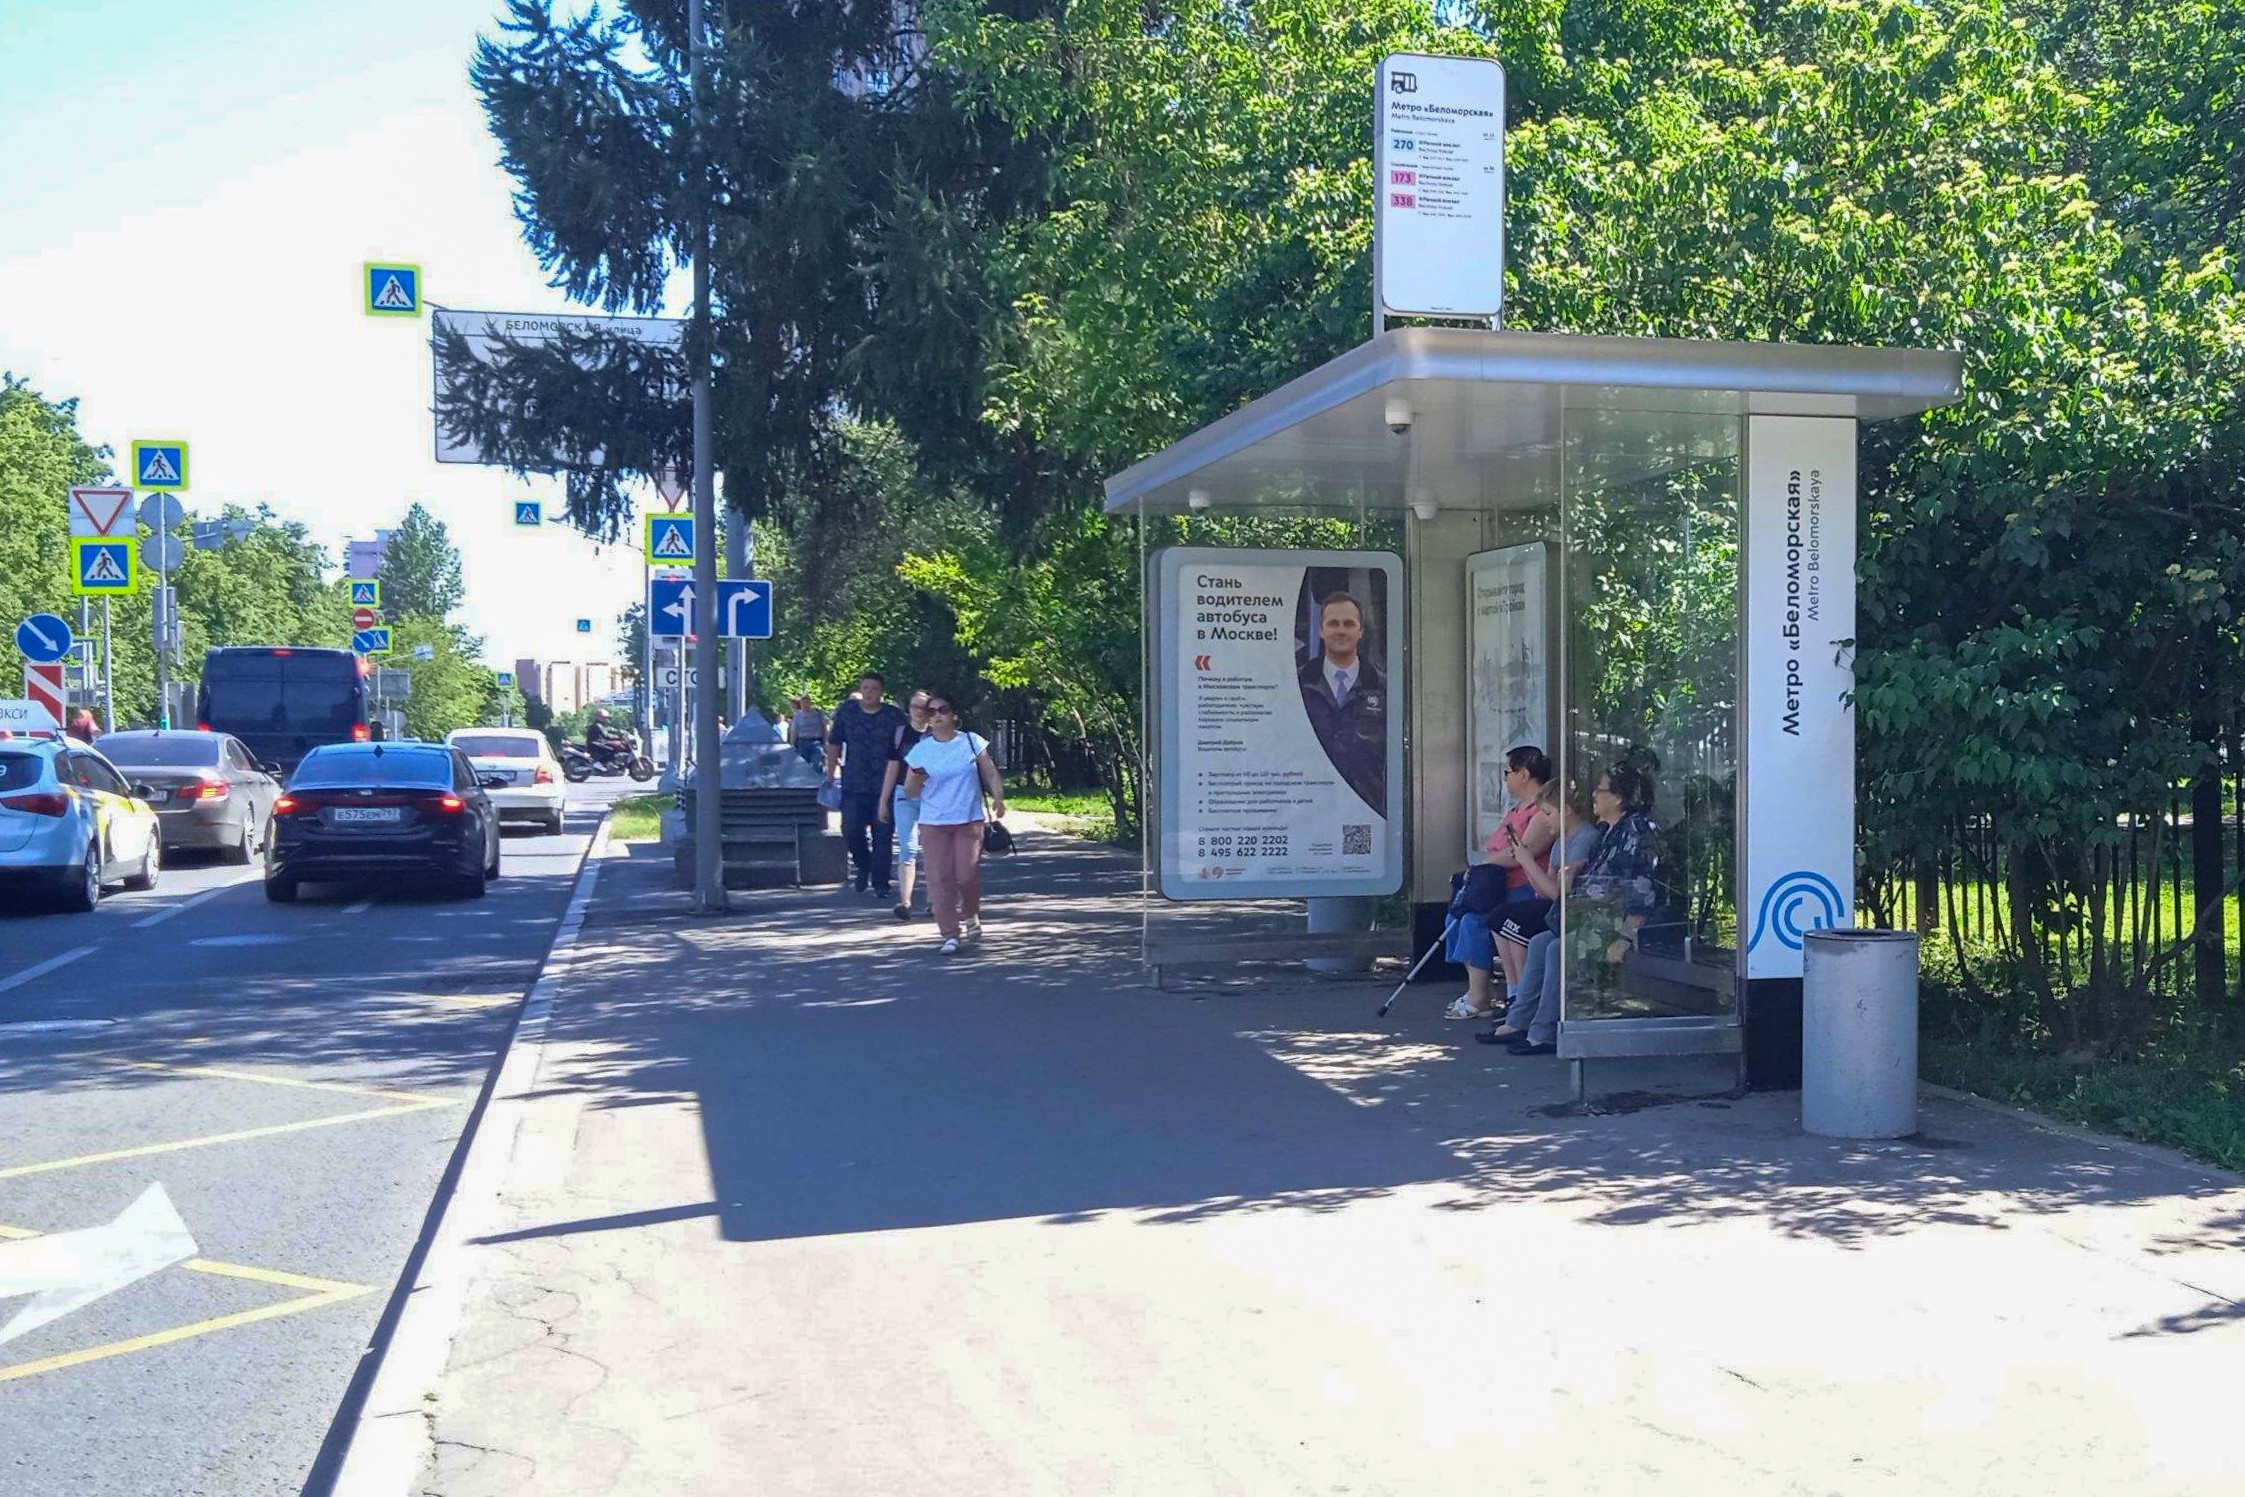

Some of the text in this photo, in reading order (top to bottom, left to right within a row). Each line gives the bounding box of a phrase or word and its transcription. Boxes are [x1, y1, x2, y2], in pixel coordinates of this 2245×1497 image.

[1392, 101, 1494, 117] Метро «Беломорская»
[1393, 139, 1414, 150] 270
[1395, 173, 1411, 183] 173
[1394, 195, 1413, 206] 338
[1807, 470, 1822, 621] Metro Belomorskaya
[1197, 574, 1242, 589] Стань
[1197, 595, 1284, 607] водителем
[1783, 470, 1804, 736] Метро «Беломорская»
[1197, 609, 1267, 627] автобуса
[1197, 627, 1278, 641] в Москве!
[1198, 835, 1288, 846] 8 800 220 2202
[1198, 846, 1288, 857] 8 495 622 2222
